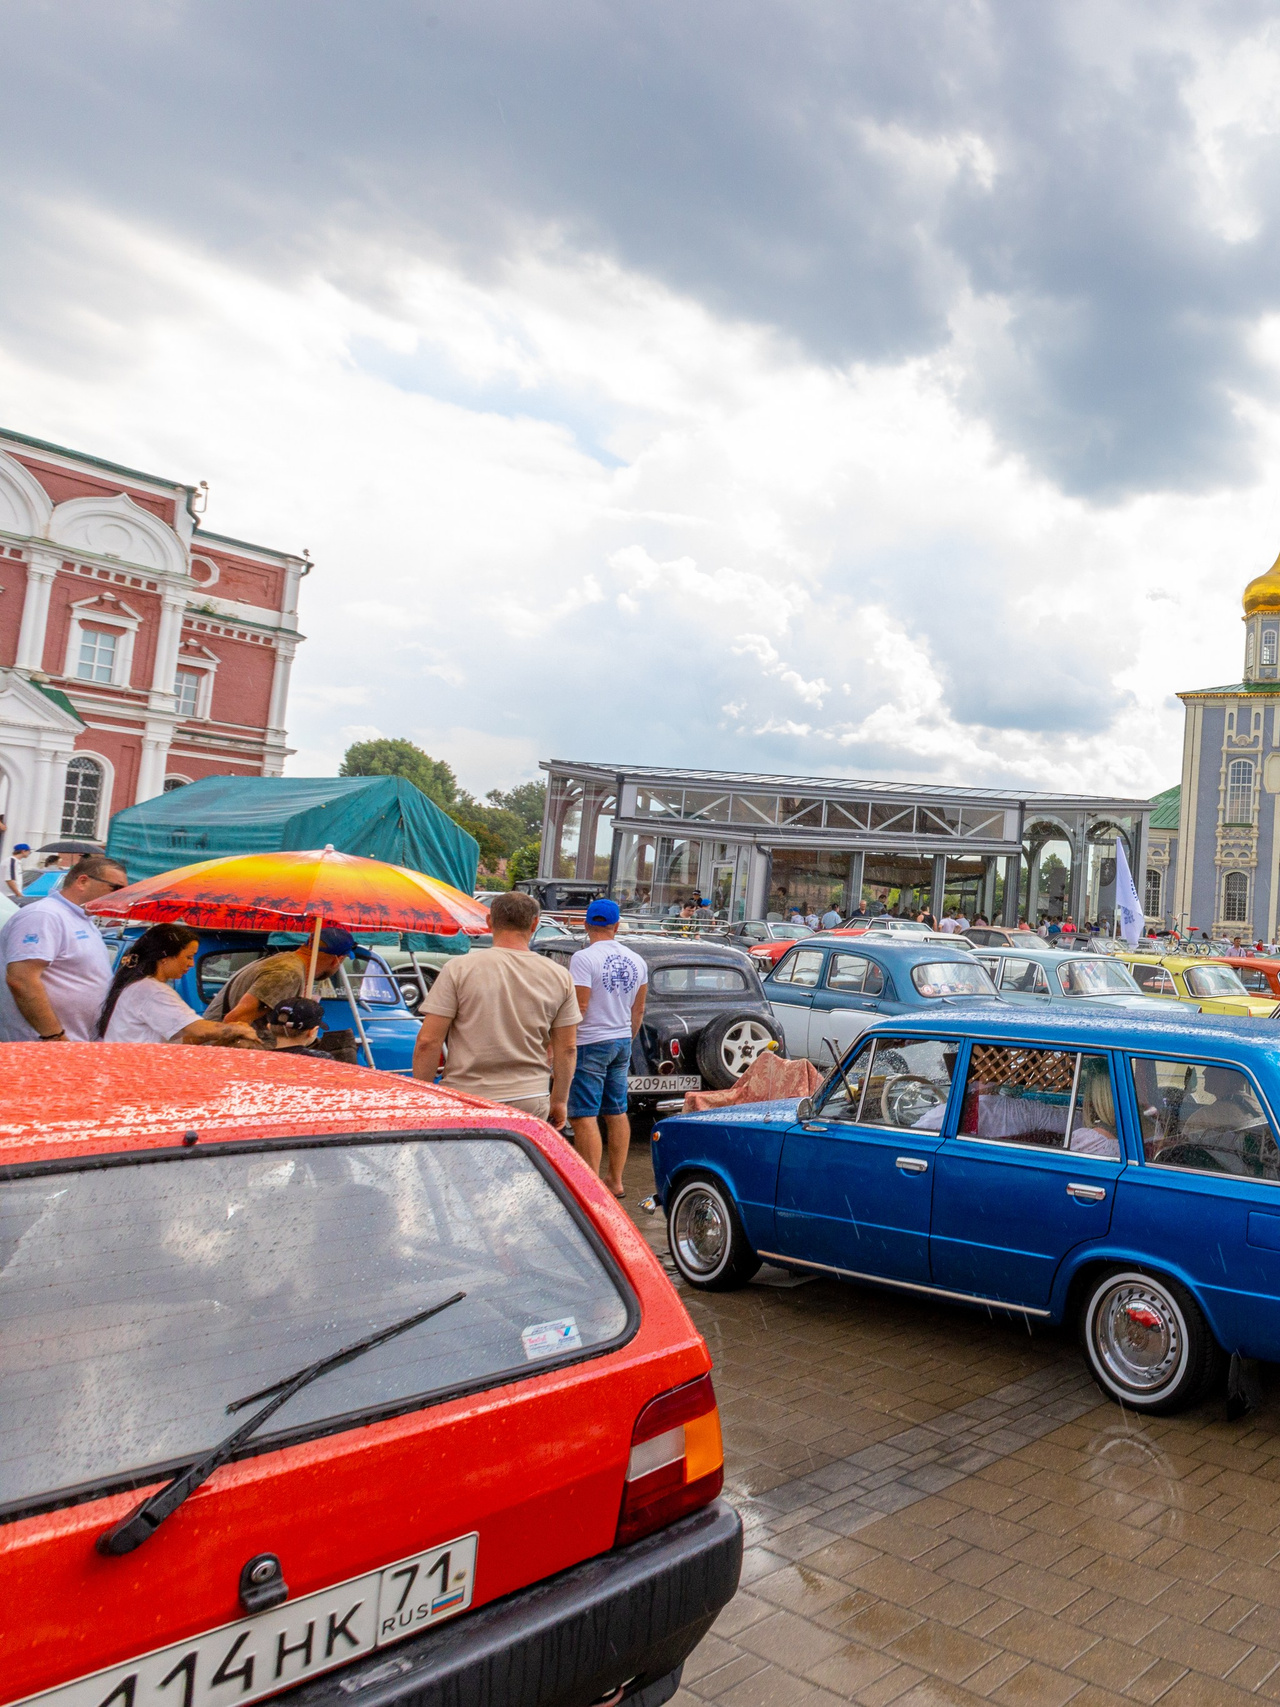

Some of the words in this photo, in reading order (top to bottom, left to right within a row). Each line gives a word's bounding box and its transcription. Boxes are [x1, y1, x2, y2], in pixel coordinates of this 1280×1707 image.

[680, 1076, 698, 1086] 799
[389, 1549, 452, 1615] 71
[380, 1603, 431, 1636] RUS
